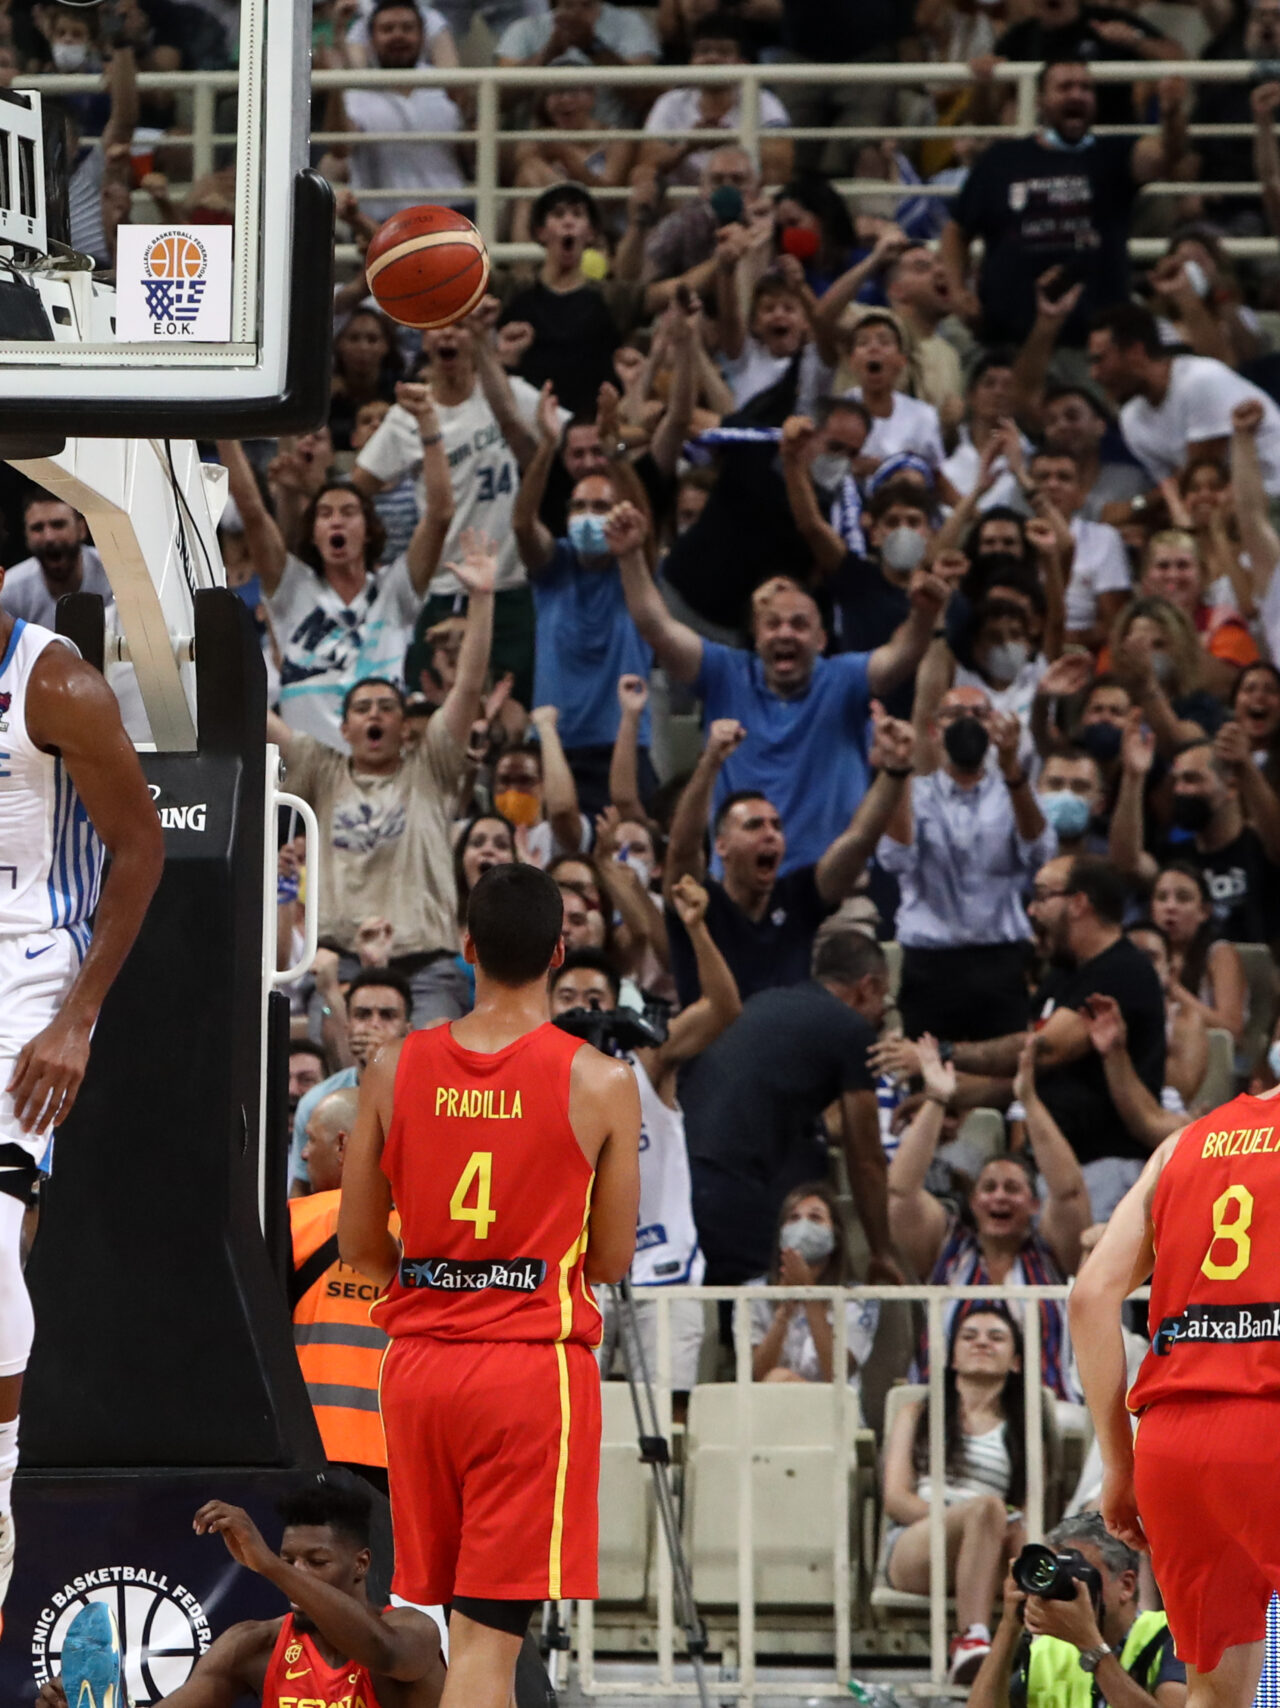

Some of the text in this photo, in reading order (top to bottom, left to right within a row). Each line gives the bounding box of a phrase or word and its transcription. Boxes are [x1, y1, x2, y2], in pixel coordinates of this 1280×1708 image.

[151, 230, 193, 245] BASKETBALL
[193, 238, 208, 279] FEDERATION
[434, 1087, 523, 1119] PRADILLA
[449, 1151, 497, 1240] 4
[1200, 1184, 1255, 1281] 8
[31, 1566, 213, 1689] ELLENIC BASKETBALL FEDERA
